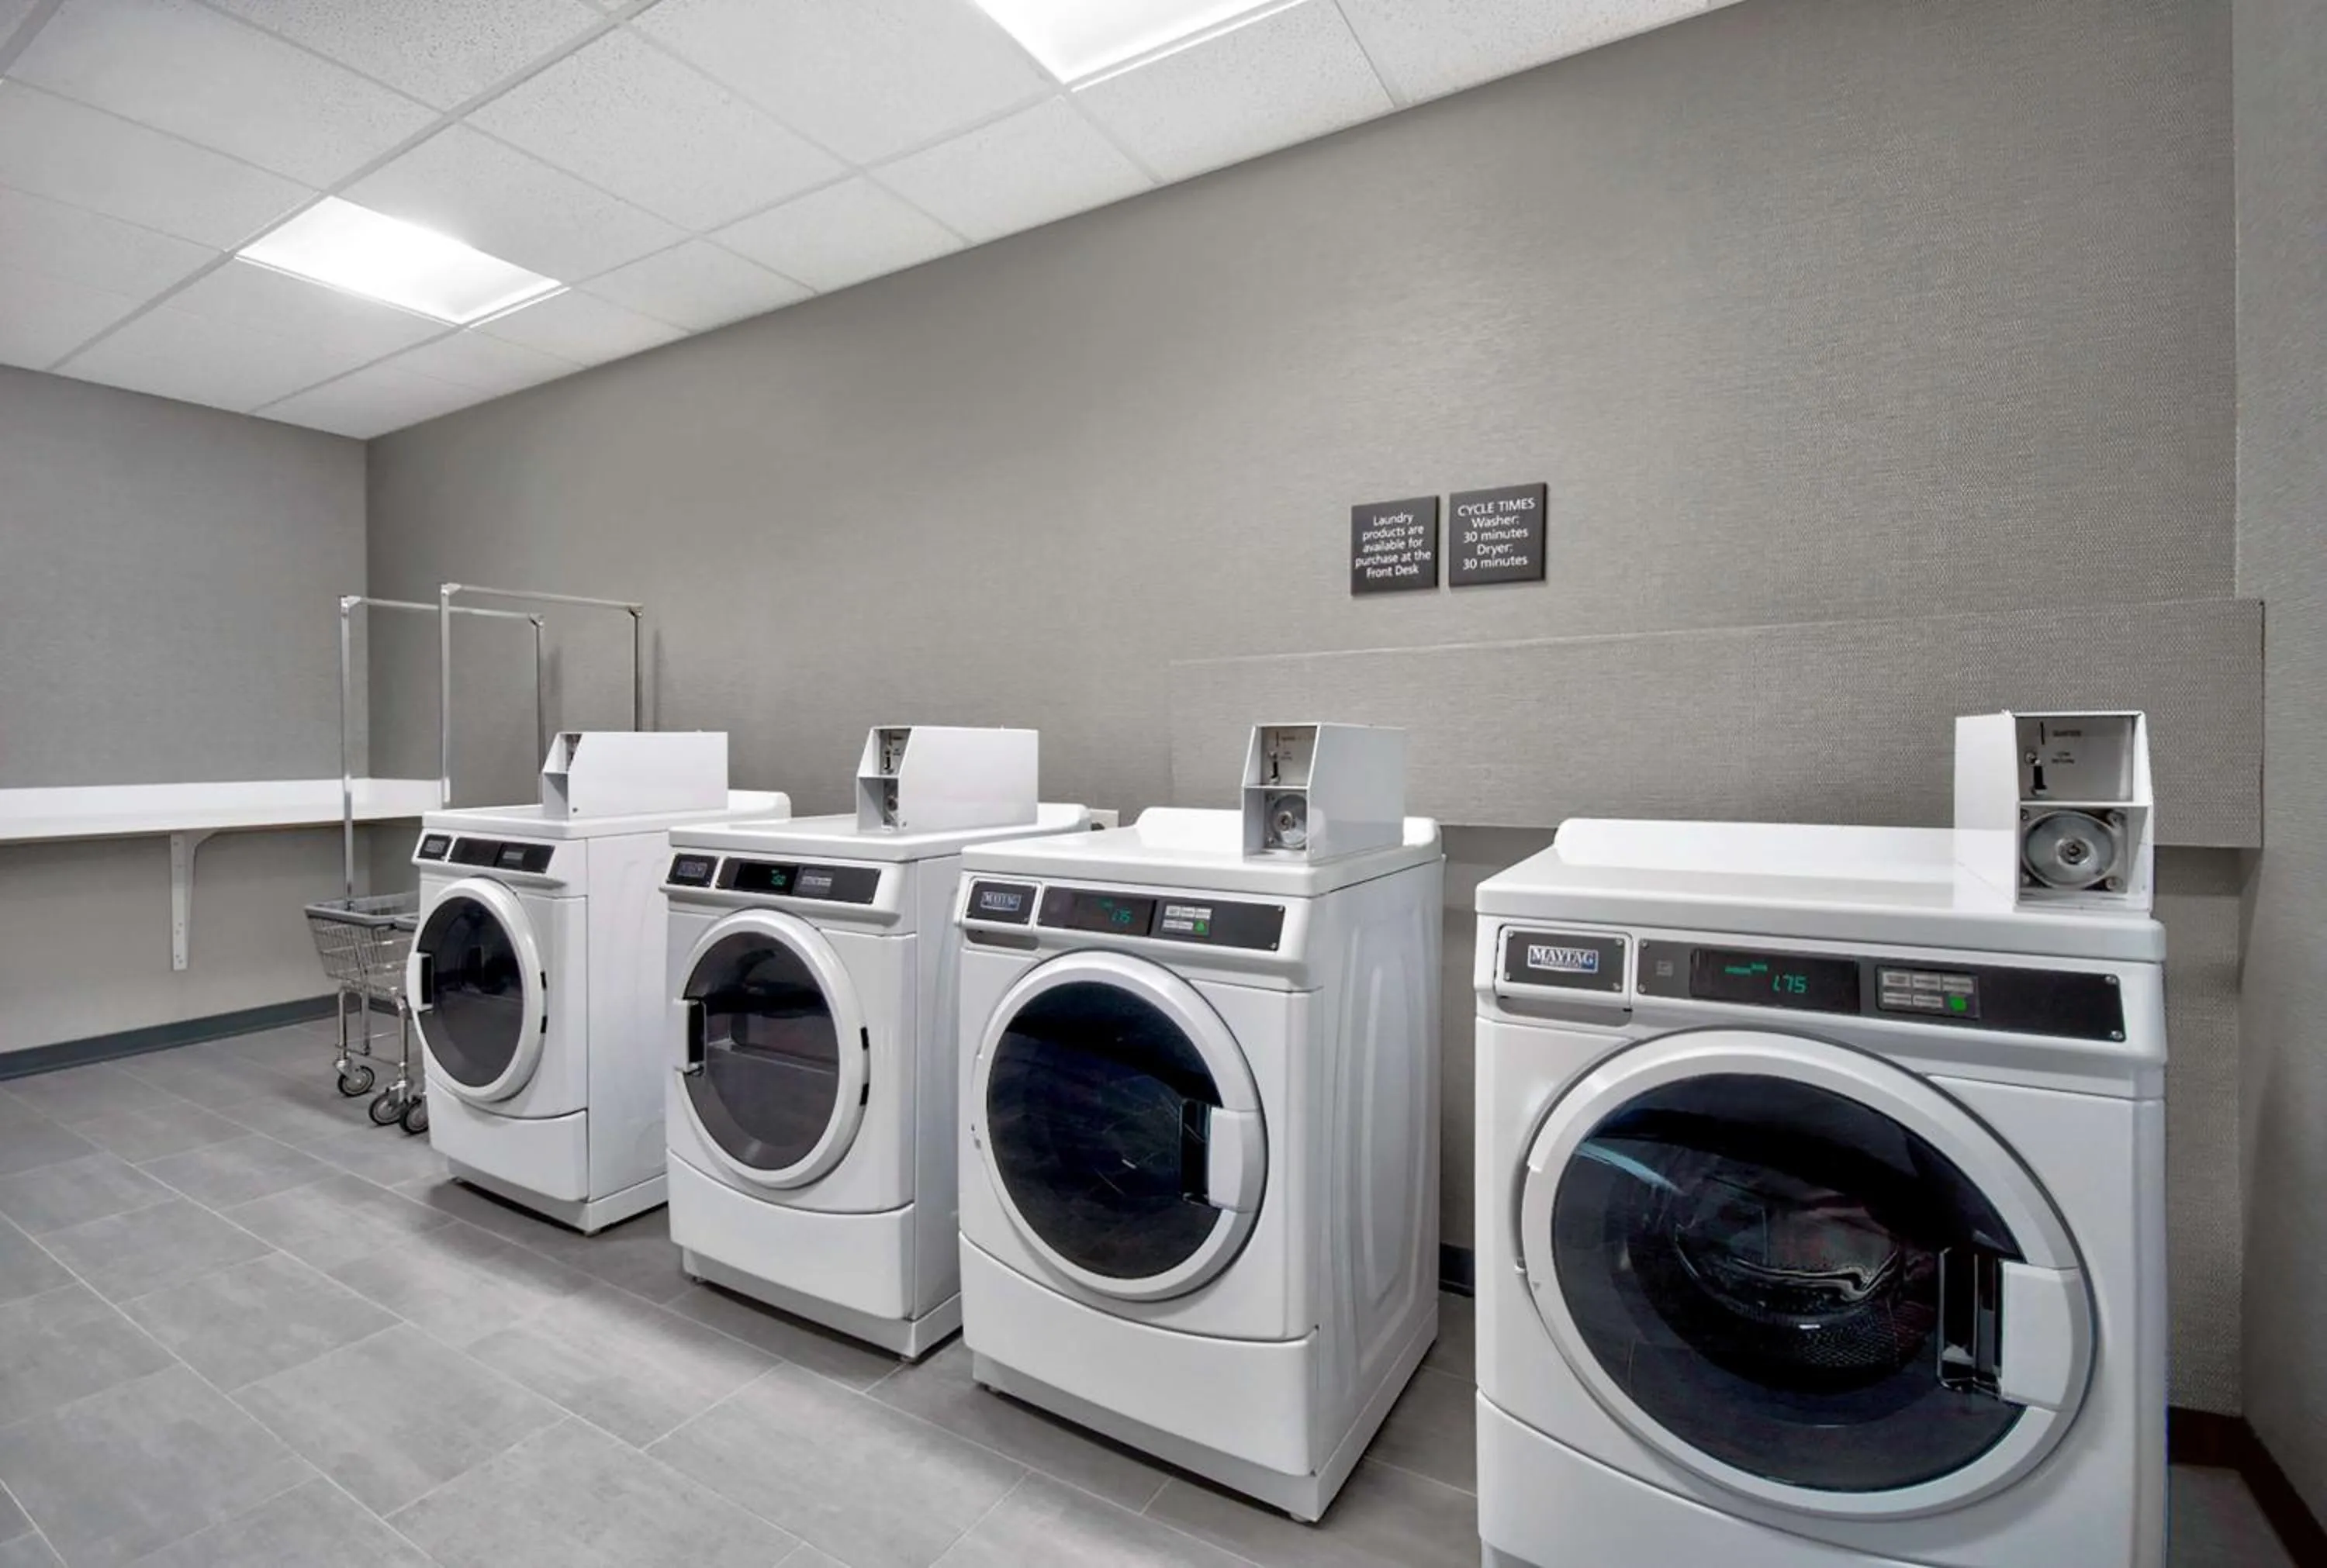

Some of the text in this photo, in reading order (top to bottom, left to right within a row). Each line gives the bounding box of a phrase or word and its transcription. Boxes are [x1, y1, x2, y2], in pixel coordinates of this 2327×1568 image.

[1458, 497, 1535, 516] CYCLE TIMES
[1373, 512, 1414, 527] Laundry
[1363, 526, 1424, 542] products are
[1464, 528, 1528, 544] 30 minutes
[1363, 537, 1423, 553] available for
[1355, 549, 1431, 569] purchase at the
[1463, 555, 1528, 571] 30 minutes
[1395, 564, 1419, 576] Desk
[1531, 947, 1596, 966] MAYTAG
